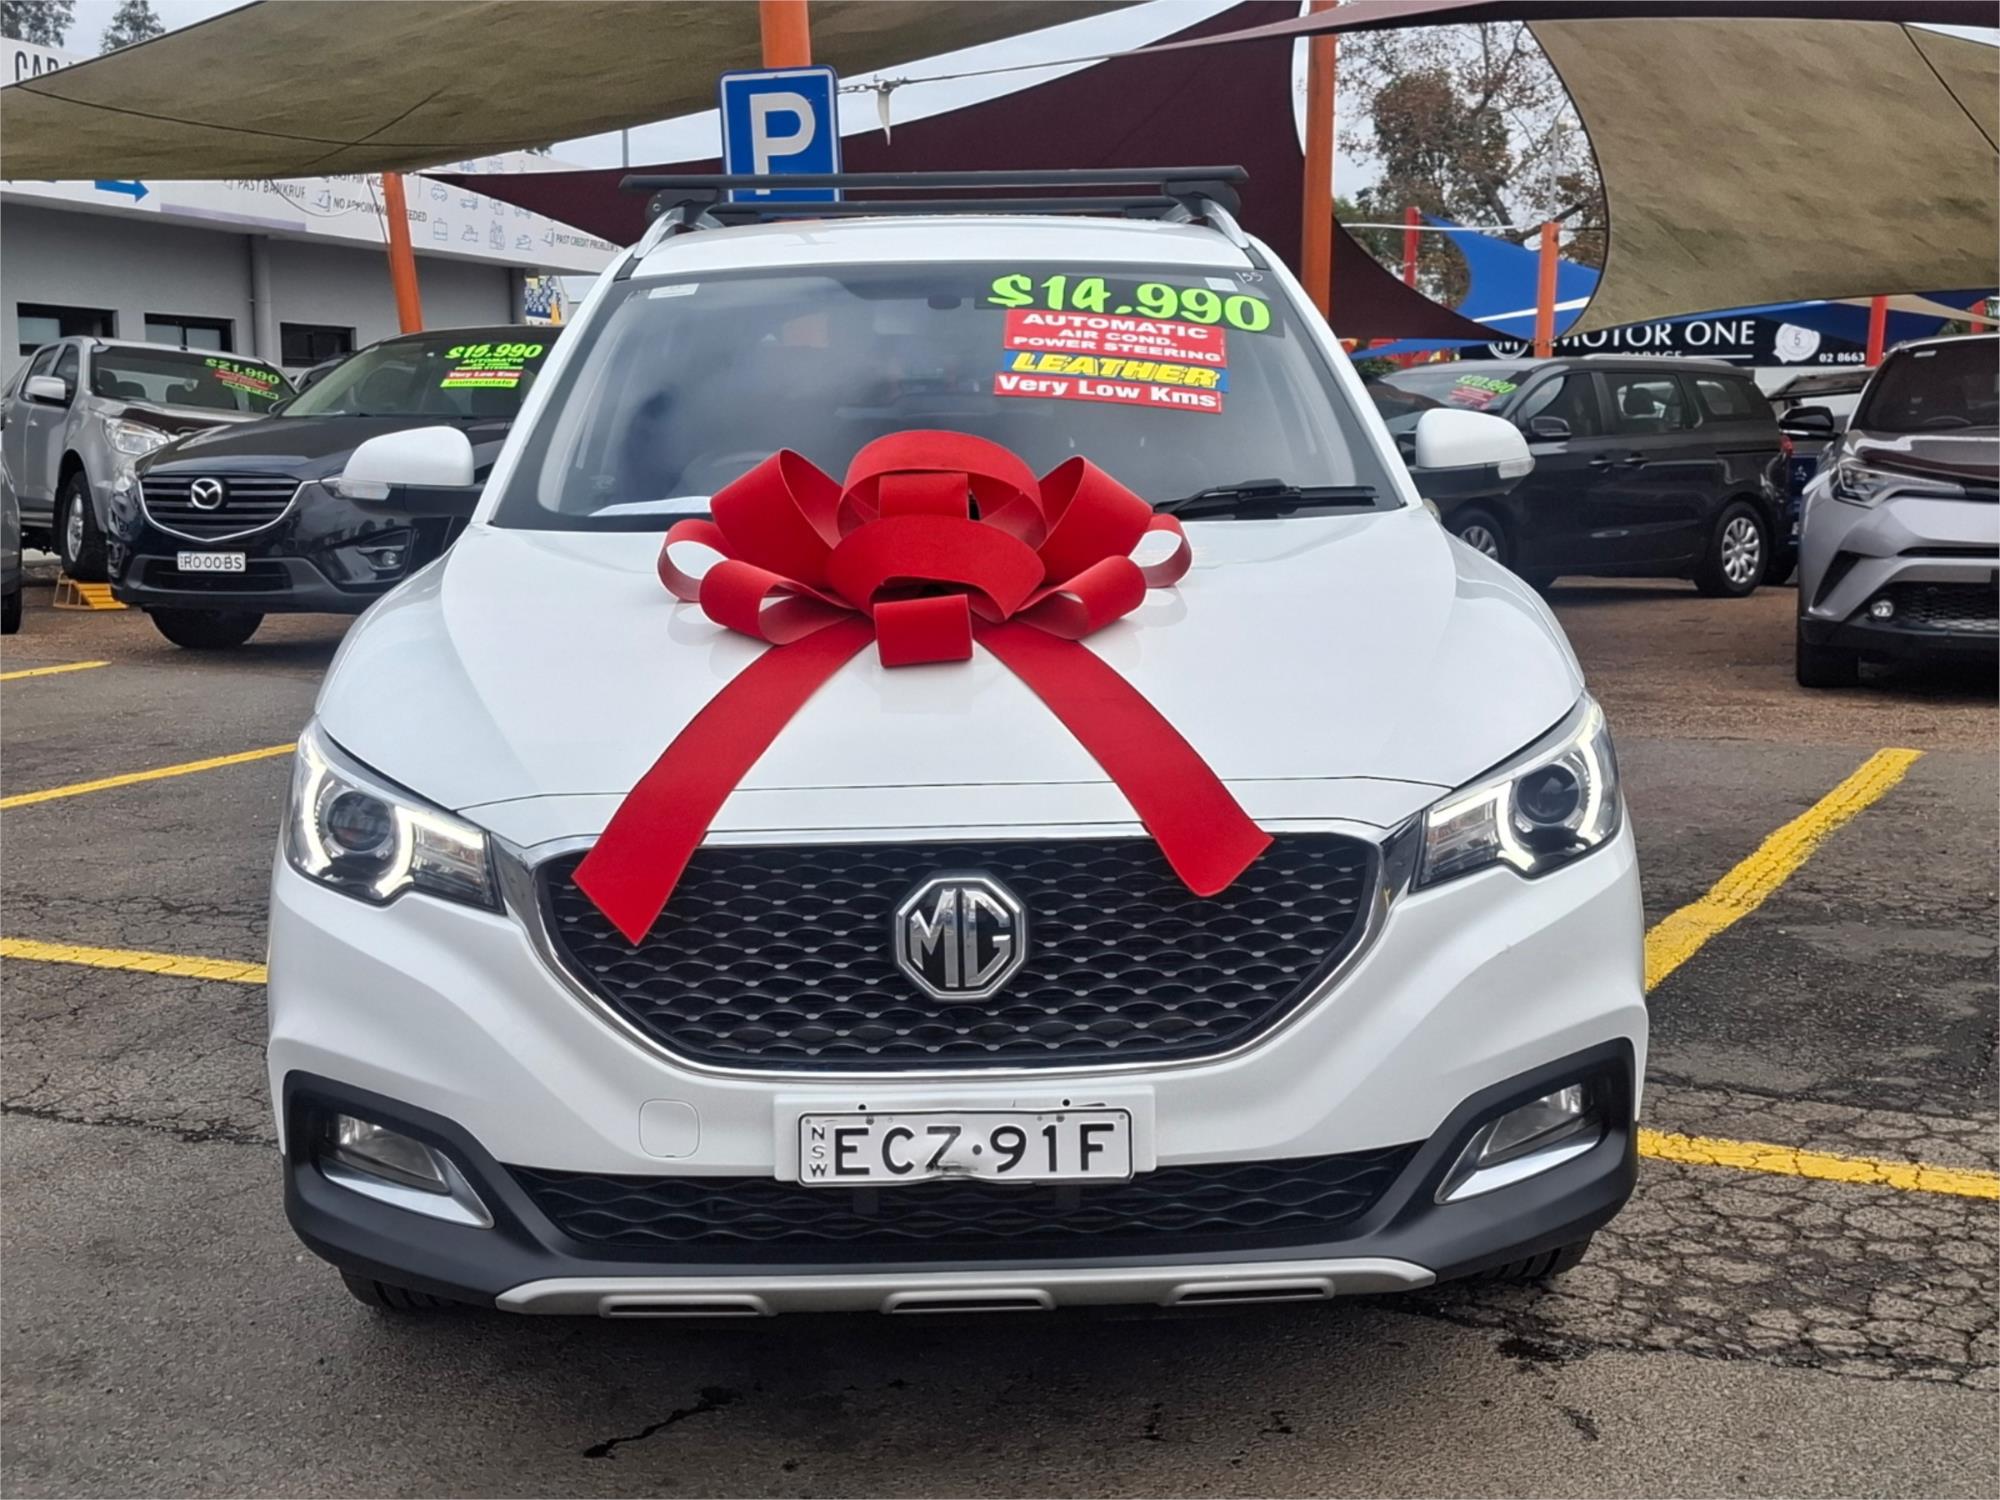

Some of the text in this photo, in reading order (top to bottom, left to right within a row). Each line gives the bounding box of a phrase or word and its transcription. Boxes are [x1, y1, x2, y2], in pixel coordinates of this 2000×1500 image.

[749, 92, 816, 195] P
[333, 197, 345, 209] NO
[1022, 312, 1208, 340] AUTOMATIC
[1059, 328, 1177, 348] AIR COND.
[1684, 320, 1756, 346] ONE
[1013, 335, 1222, 363] POWER STEERING
[1819, 351, 1866, 363] 02 8663
[1011, 352, 1220, 389] LEATHER
[998, 375, 1217, 408] Very Low Kms
[909, 887, 1011, 988] MG
